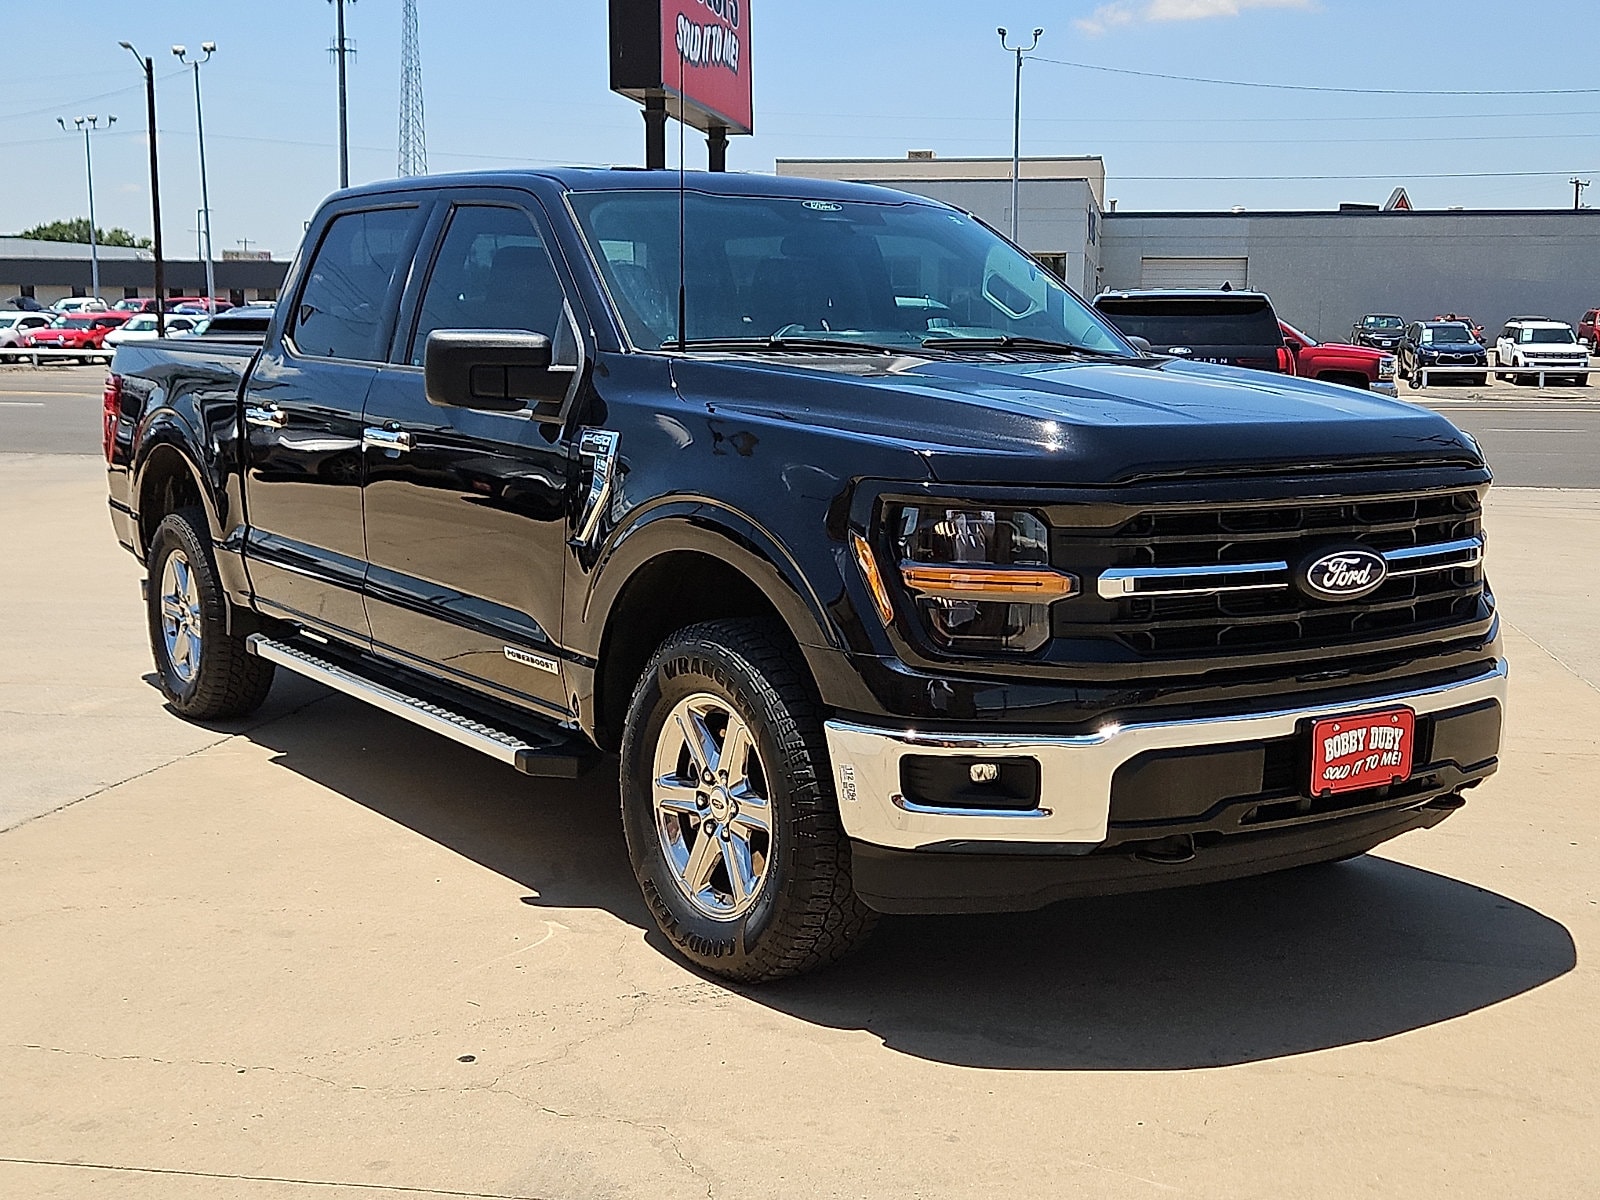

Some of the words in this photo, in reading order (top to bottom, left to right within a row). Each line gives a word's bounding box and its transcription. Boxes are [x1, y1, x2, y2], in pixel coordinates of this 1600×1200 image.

[676, 13, 701, 64] SOLD
[701, 24, 711, 65] IT
[711, 24, 722, 64] TO
[722, 26, 739, 72] ME!
[1319, 557, 1373, 588] Ford
[506, 649, 554, 671] POWERBOOST
[1323, 727, 1368, 763] BOBBY
[1368, 726, 1404, 751] DUBY
[1322, 764, 1351, 780] SOLD
[1351, 759, 1365, 776] IT
[1364, 754, 1379, 772] TO
[1380, 750, 1402, 766] ME!
